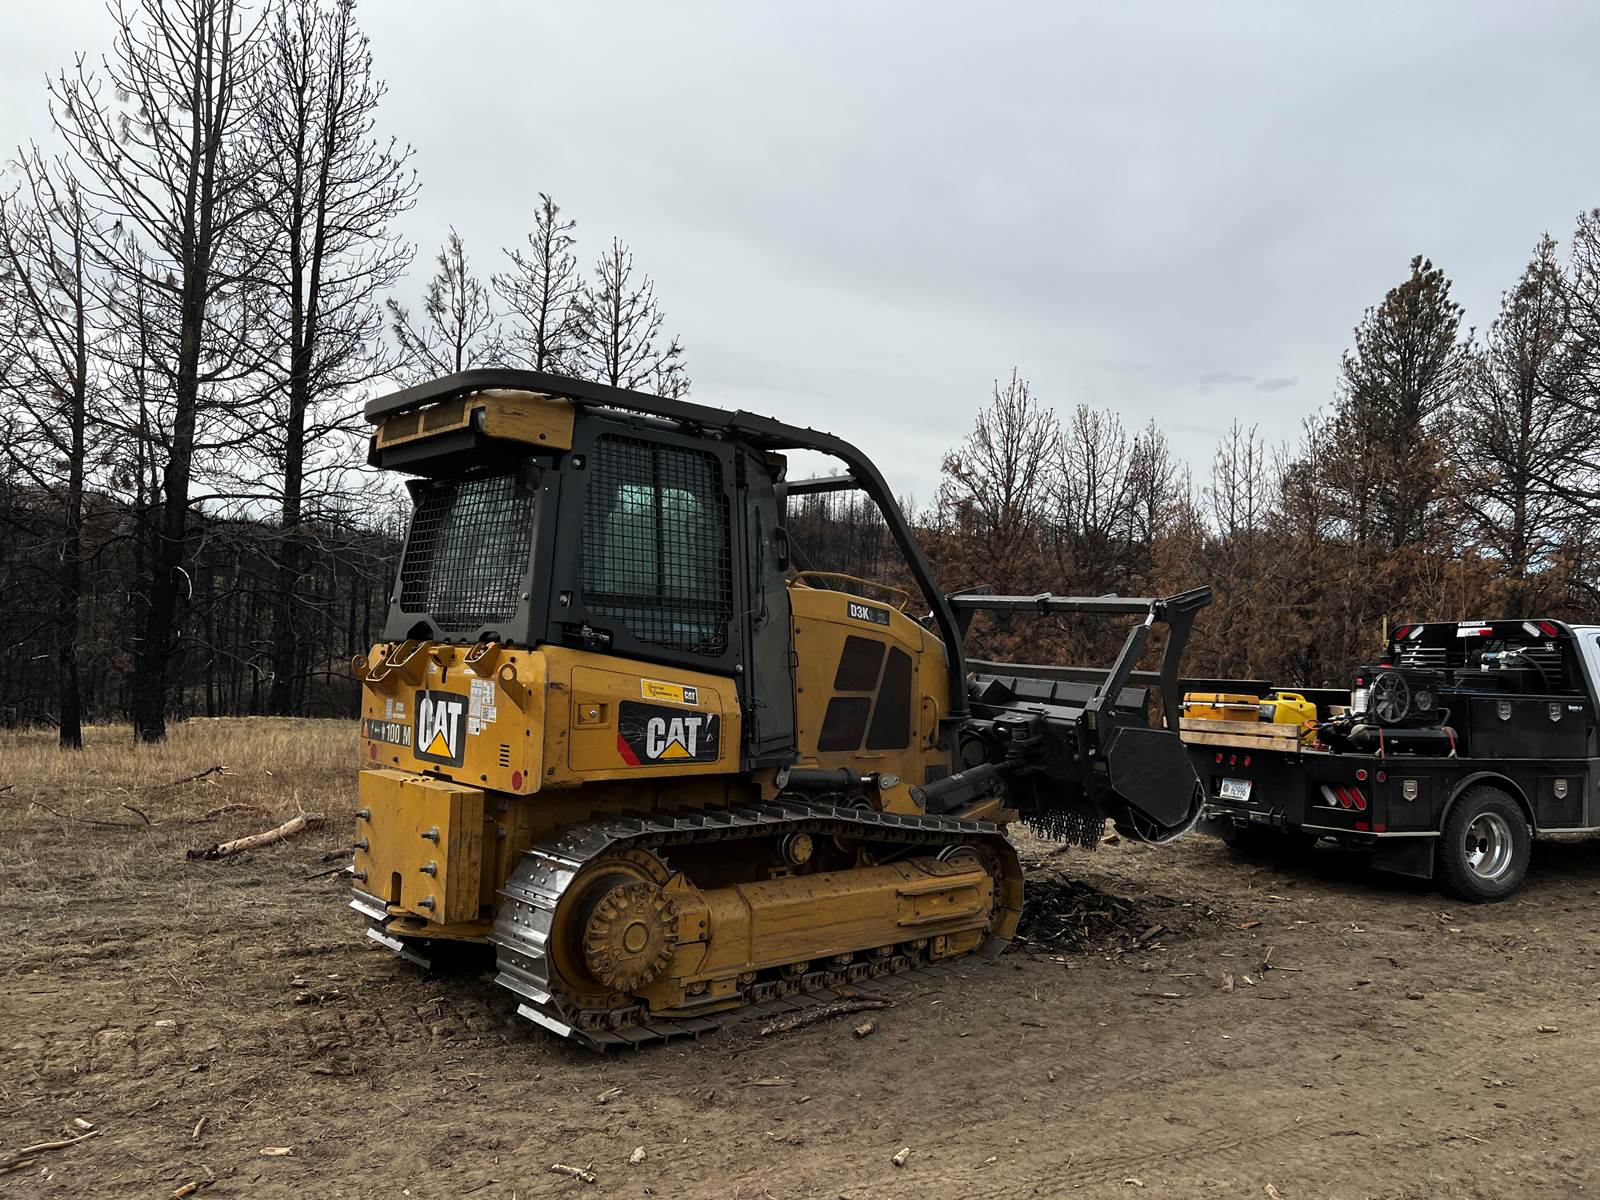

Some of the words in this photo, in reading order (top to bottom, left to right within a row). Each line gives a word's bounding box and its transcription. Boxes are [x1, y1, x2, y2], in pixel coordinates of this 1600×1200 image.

[850, 604, 870, 620] D3K
[684, 690, 696, 700] CAT
[386, 722, 401, 744] 100
[402, 725, 412, 746] M
[418, 698, 463, 759] CAT
[646, 717, 702, 759] CAT
